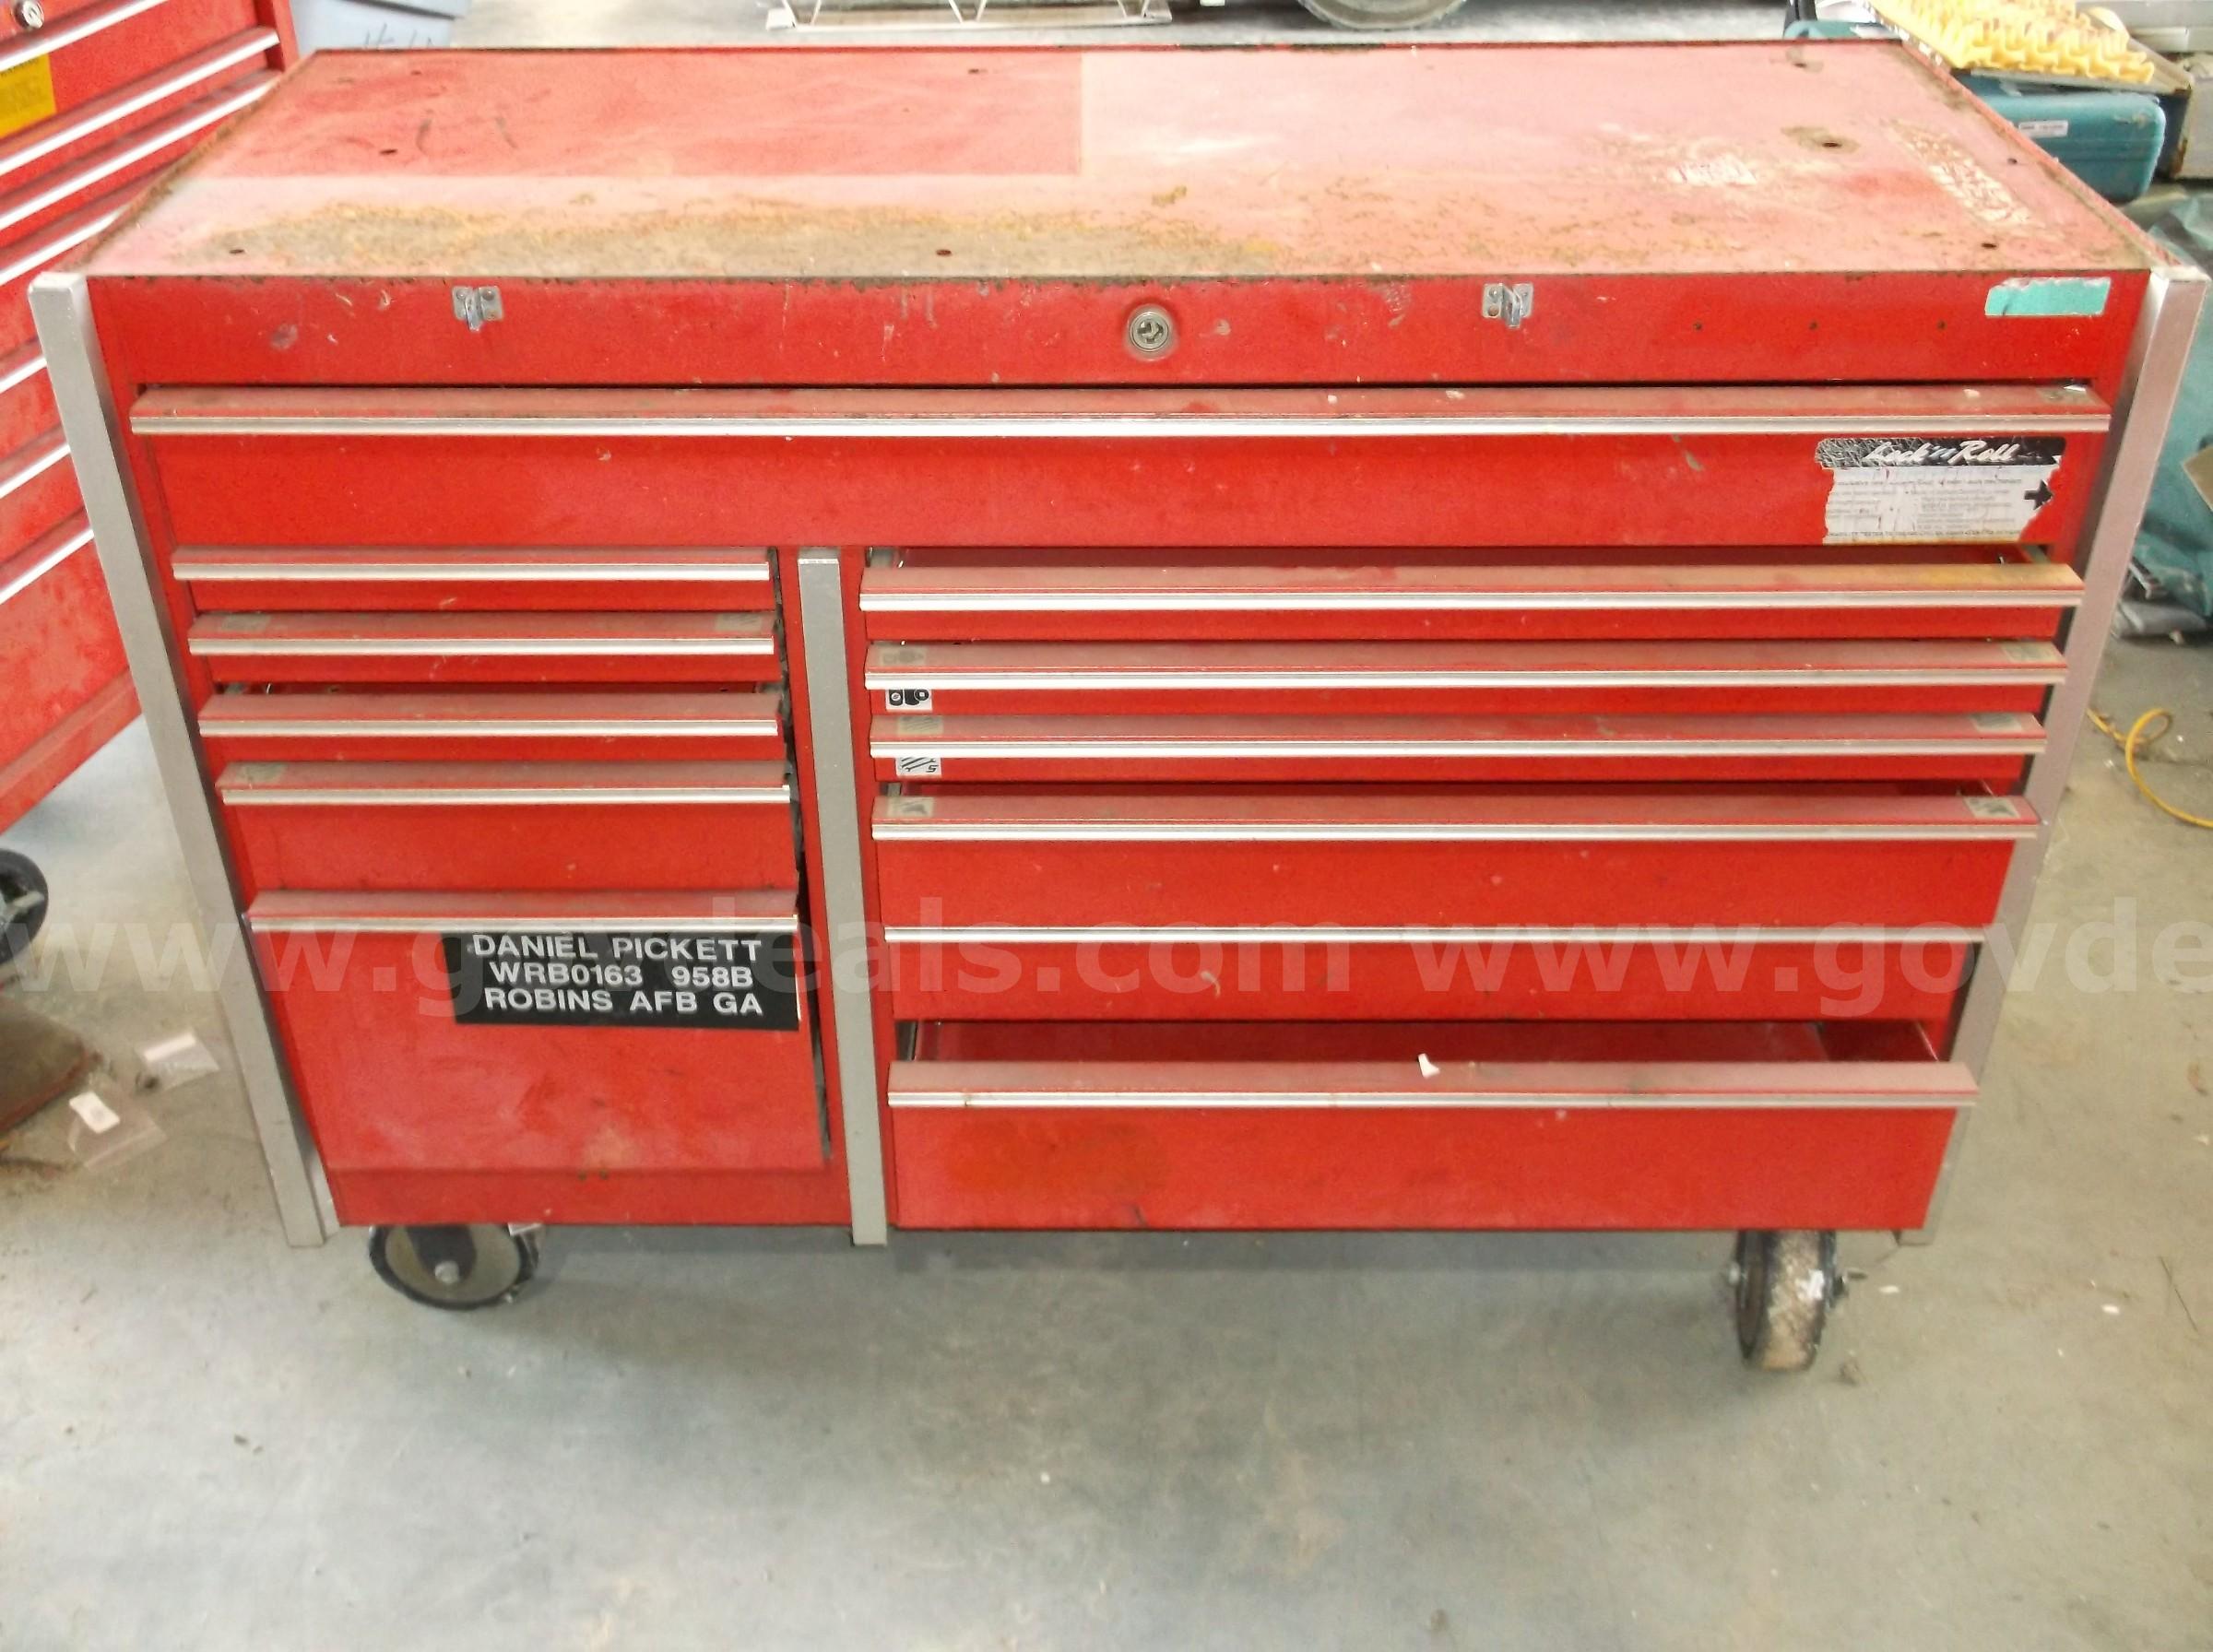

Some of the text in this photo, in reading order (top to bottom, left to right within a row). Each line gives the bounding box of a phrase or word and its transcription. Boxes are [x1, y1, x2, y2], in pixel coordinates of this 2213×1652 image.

[1947, 440, 2021, 465] Roll
[472, 933, 762, 962] DANIEL PICKETT
[490, 961, 754, 989] WRB0163 958B
[483, 987, 764, 1016] ROBINS AFB GA
